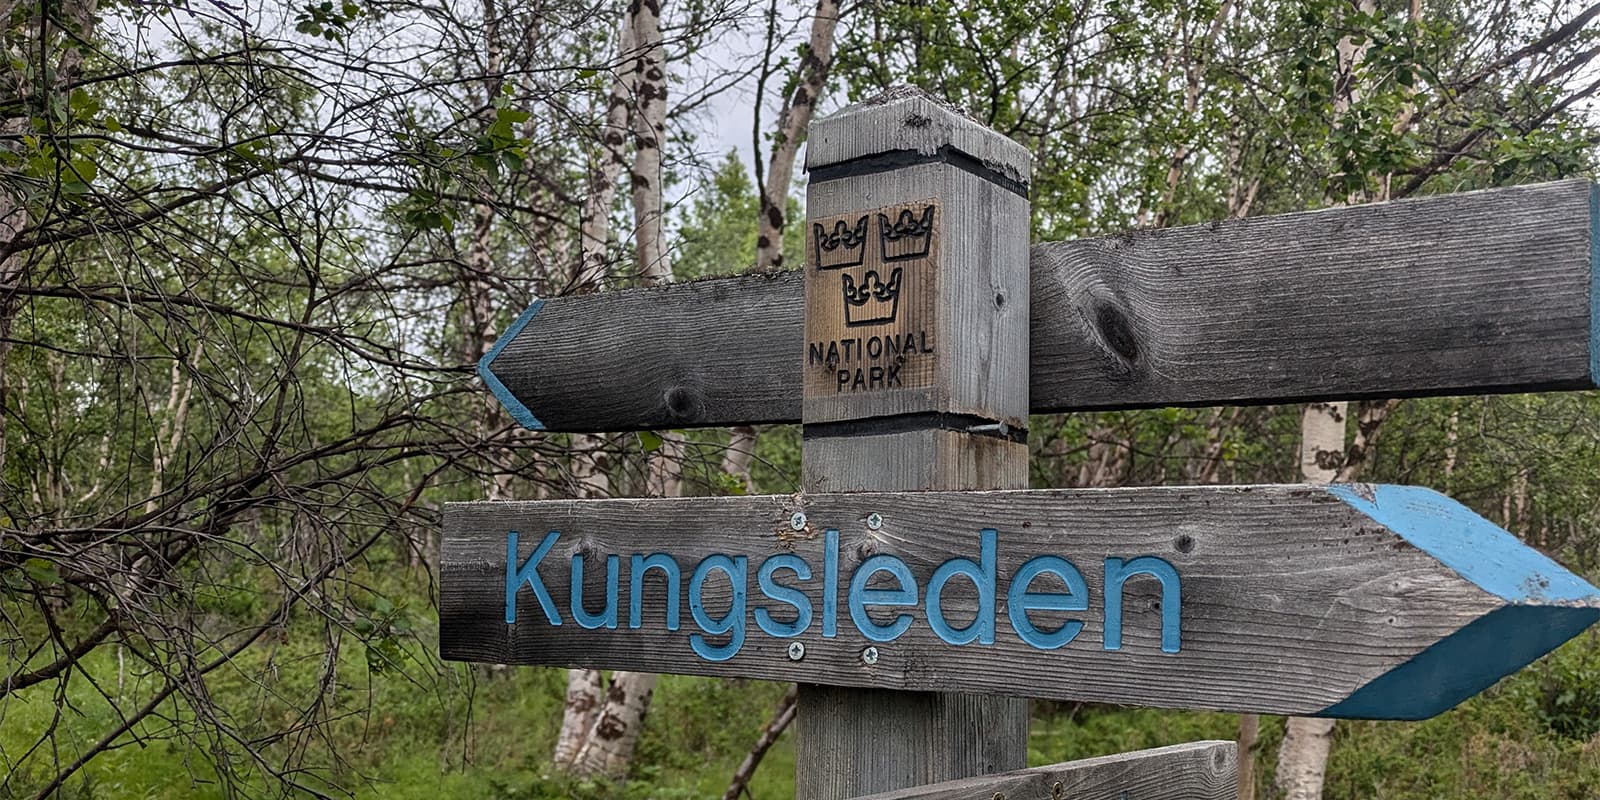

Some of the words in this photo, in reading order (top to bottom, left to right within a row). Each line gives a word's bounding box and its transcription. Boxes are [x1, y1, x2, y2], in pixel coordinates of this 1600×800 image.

[809, 330, 933, 365] NATIONAL
[837, 365, 902, 392] PARK
[506, 528, 1182, 662] Kungsleden
